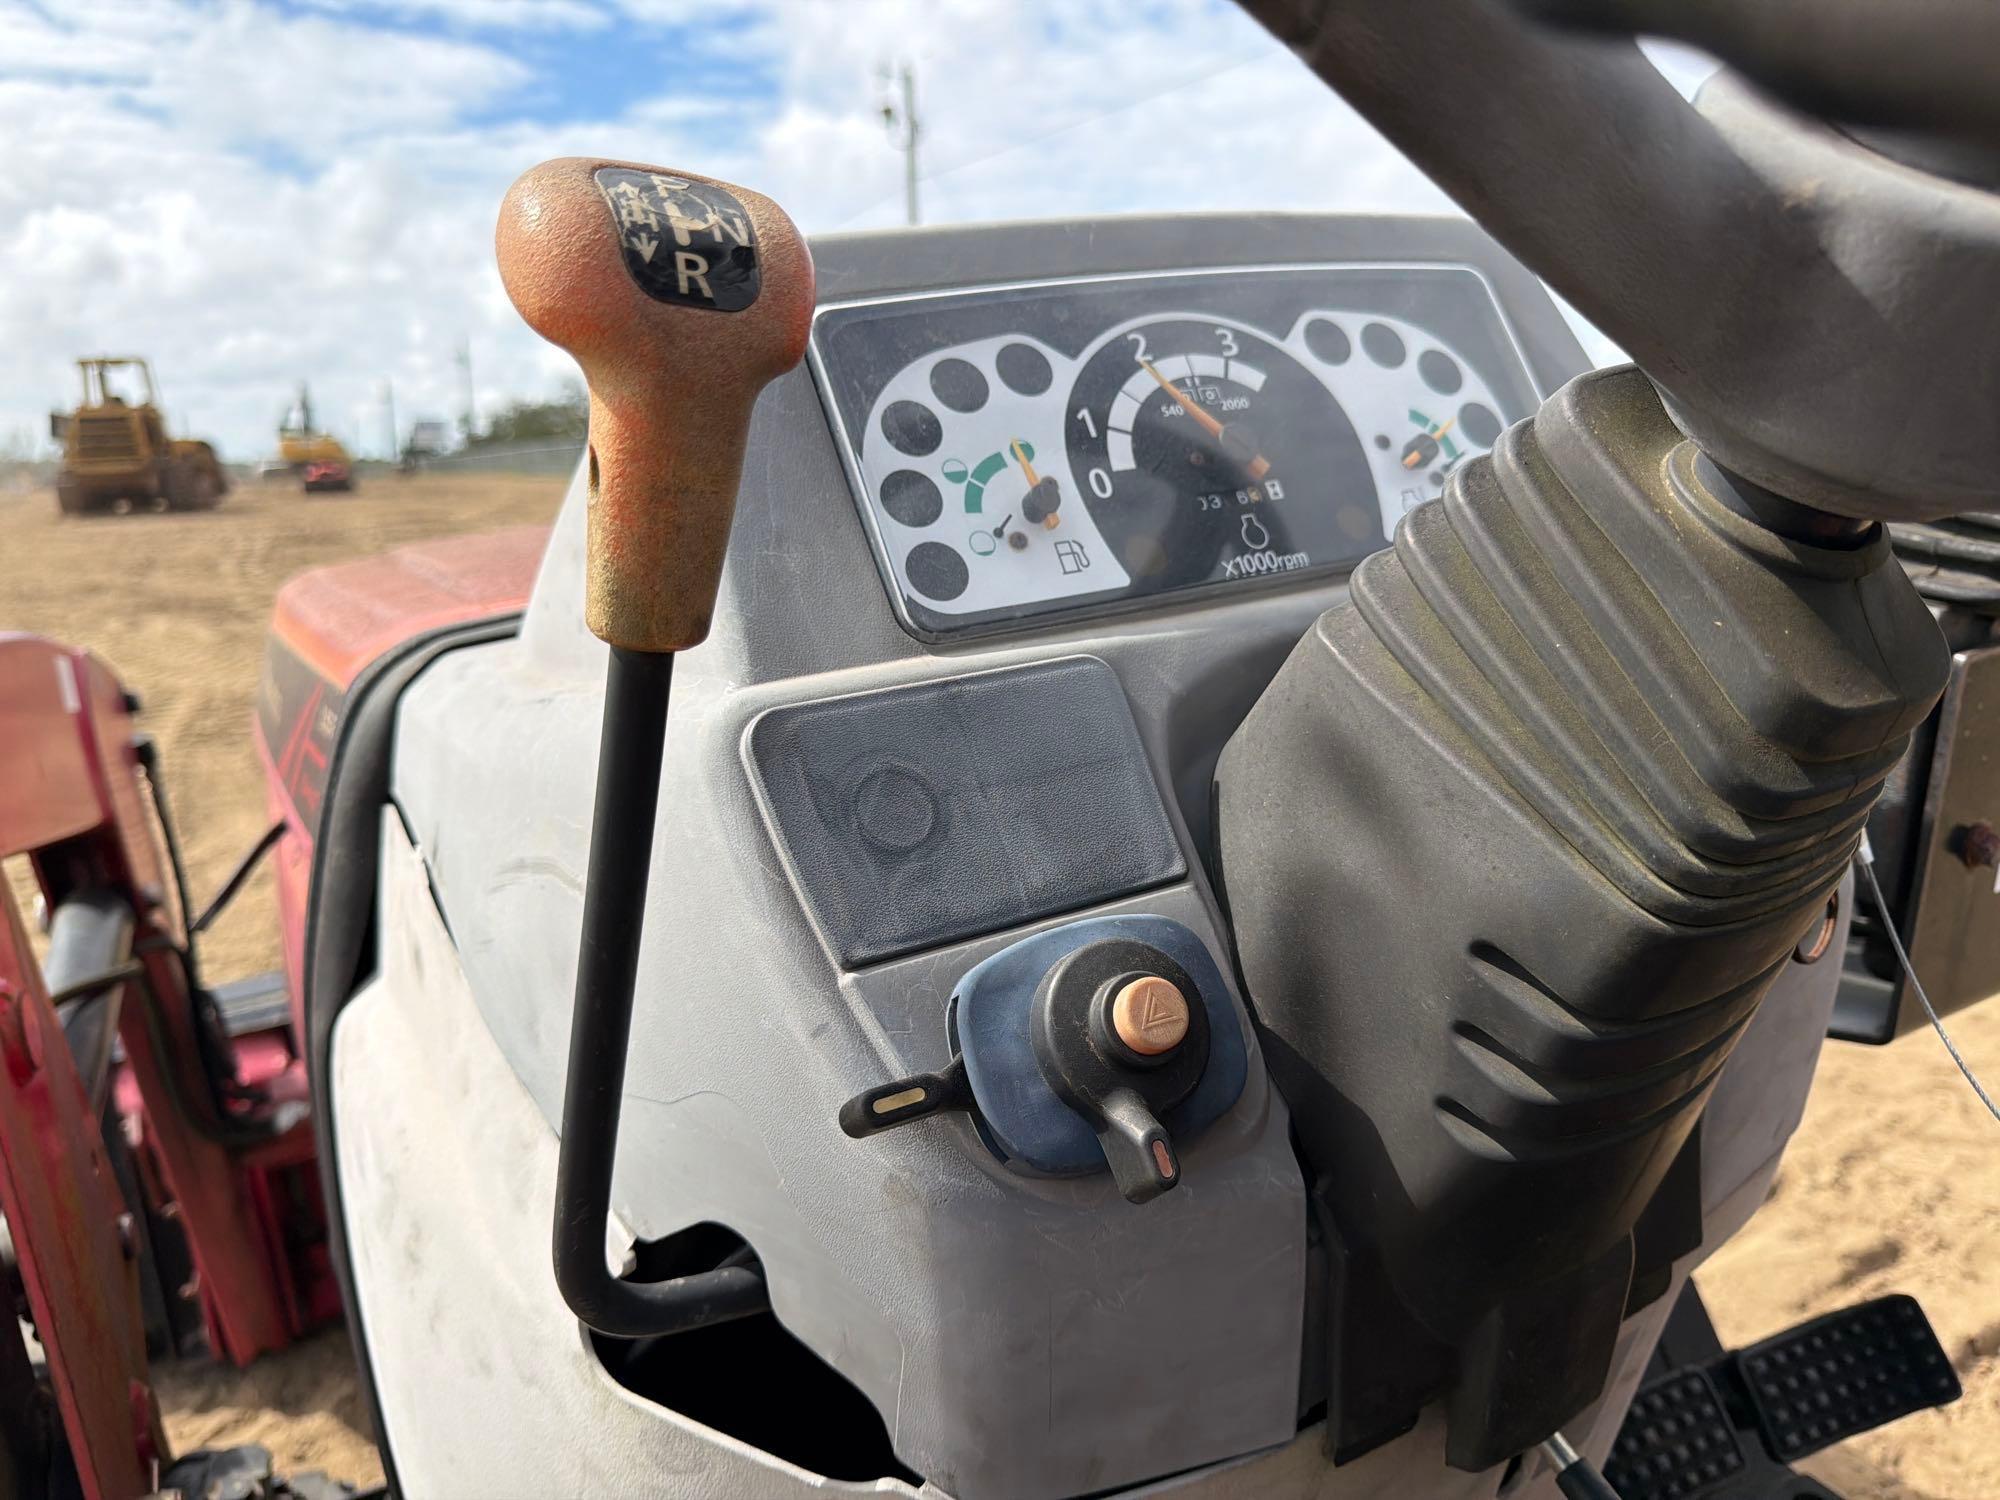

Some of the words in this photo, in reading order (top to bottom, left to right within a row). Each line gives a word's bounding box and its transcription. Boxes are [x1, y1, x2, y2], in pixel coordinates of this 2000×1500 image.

[706, 212, 750, 247] N
[675, 251, 713, 298] R
[1127, 333, 1153, 362] 2
[1215, 328, 1239, 356] 3
[1160, 404, 1185, 419] 540
[1221, 397, 1249, 411] 2000
[1076, 407, 1098, 439] 1
[1088, 469, 1113, 498] 0
